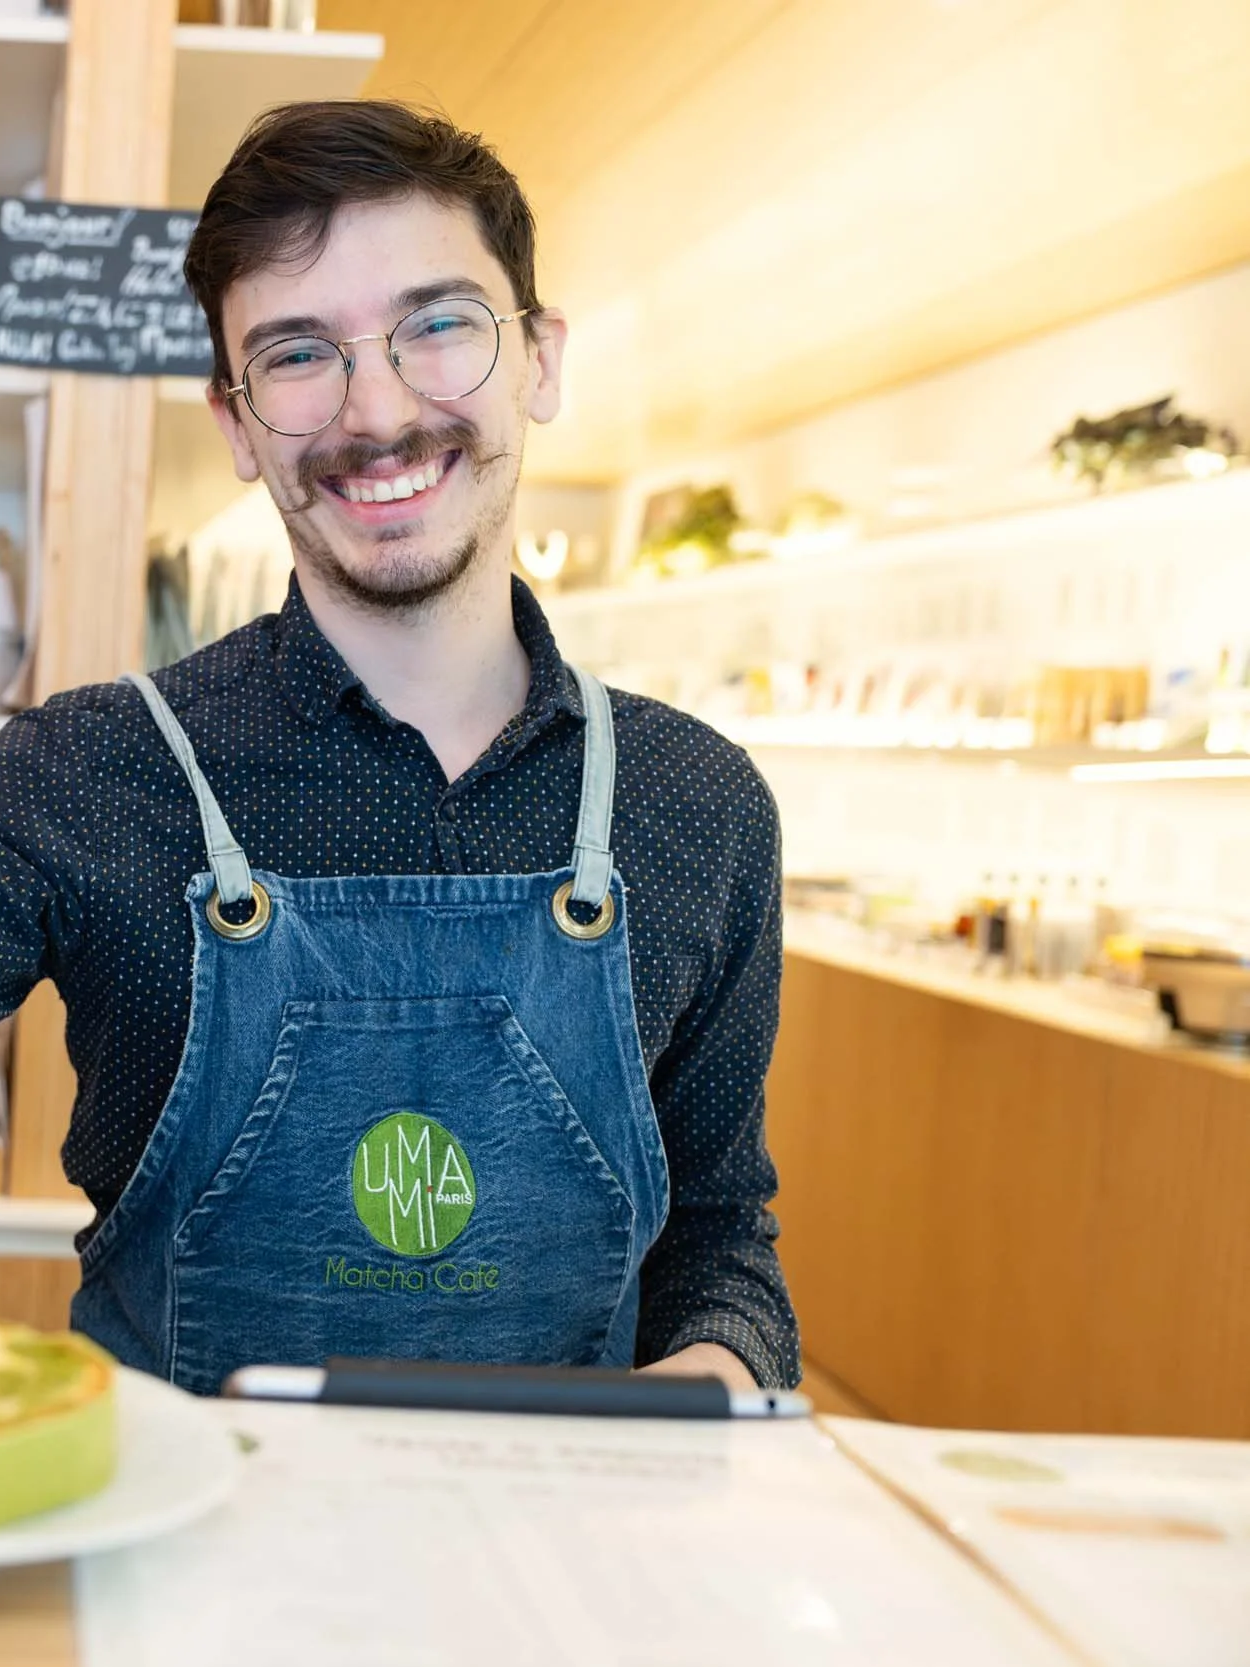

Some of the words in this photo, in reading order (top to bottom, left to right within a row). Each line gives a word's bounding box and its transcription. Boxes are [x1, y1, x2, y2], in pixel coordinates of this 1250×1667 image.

[436, 1192, 473, 1205] PARIS
[325, 1256, 424, 1291] Matcha
[434, 1263, 500, 1291] Café
